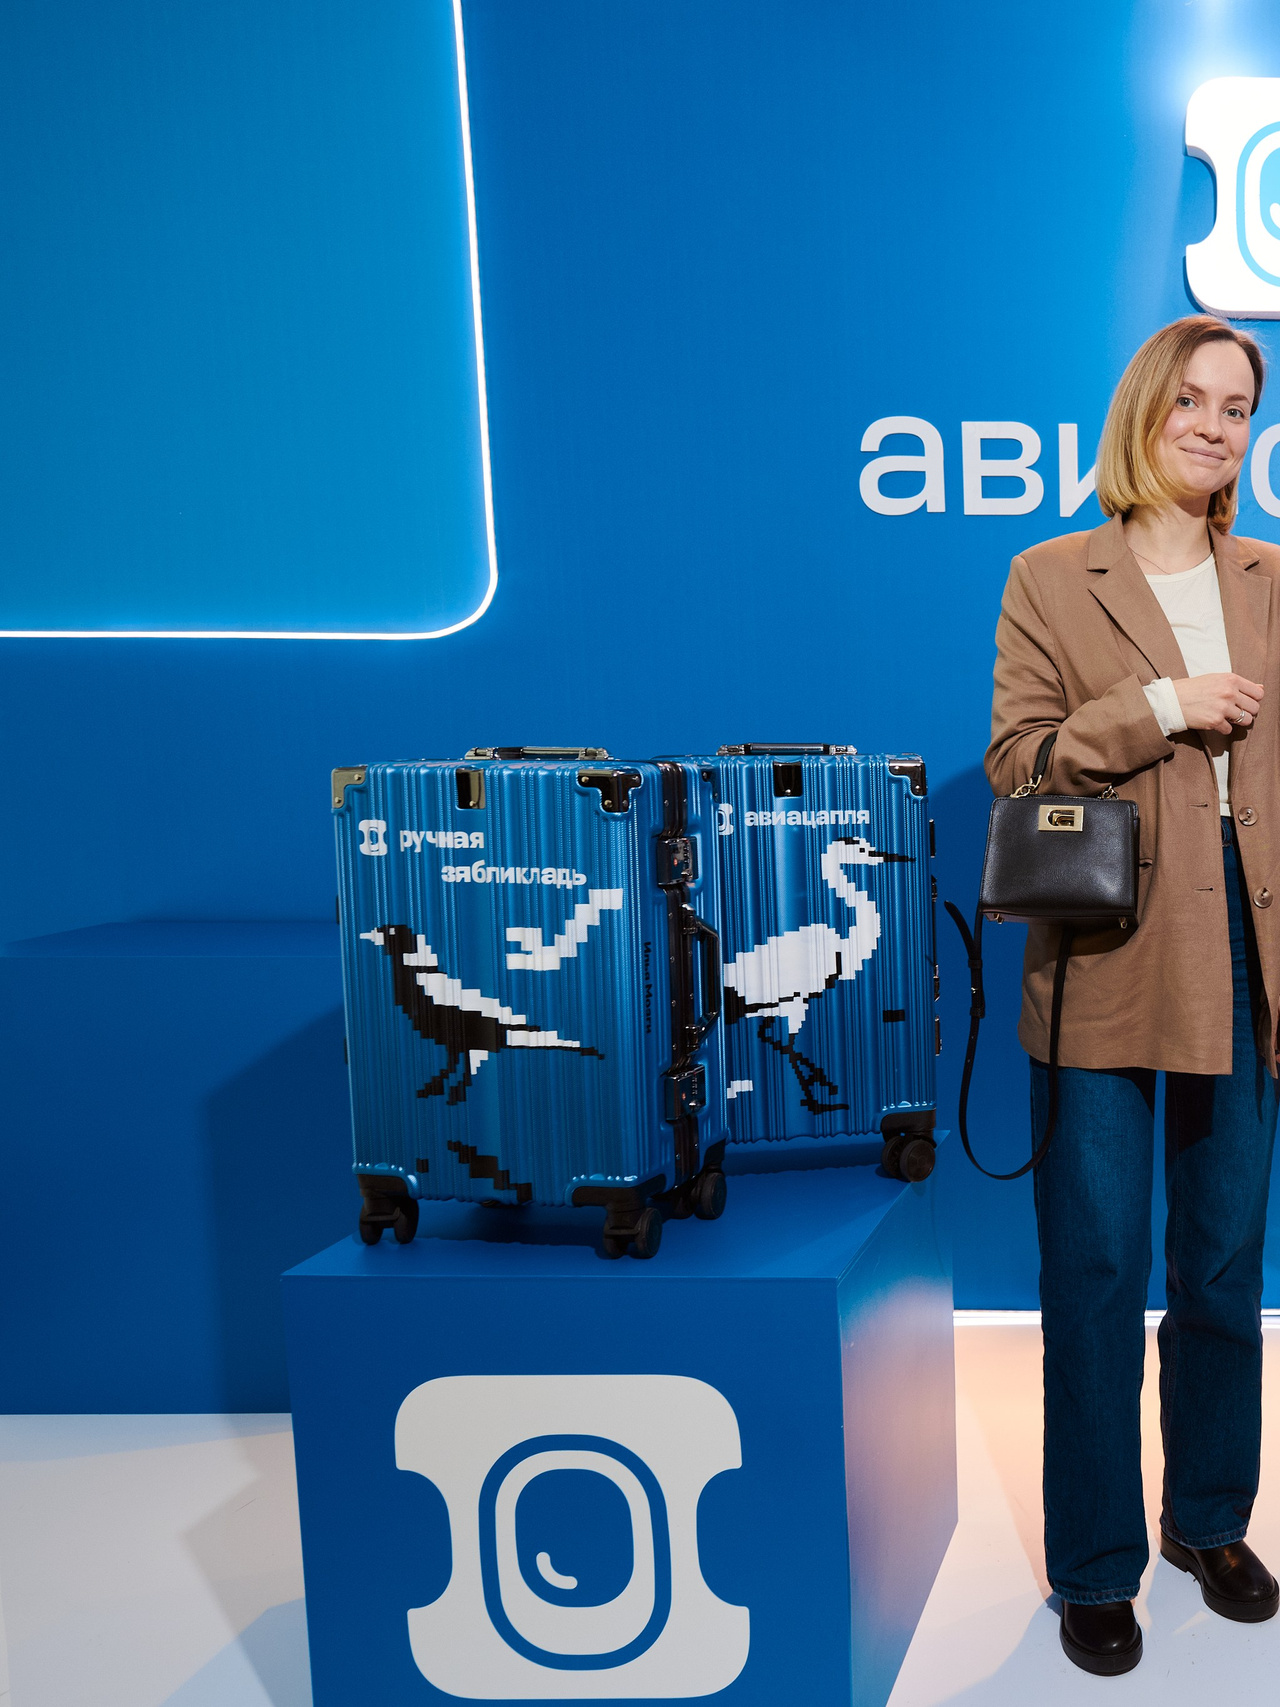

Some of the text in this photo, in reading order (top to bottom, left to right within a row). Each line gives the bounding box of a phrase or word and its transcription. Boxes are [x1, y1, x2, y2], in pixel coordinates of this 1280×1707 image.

[744, 809, 870, 829] авиацапля
[399, 829, 485, 853] ручная
[440, 859, 588, 890] зябликладь
